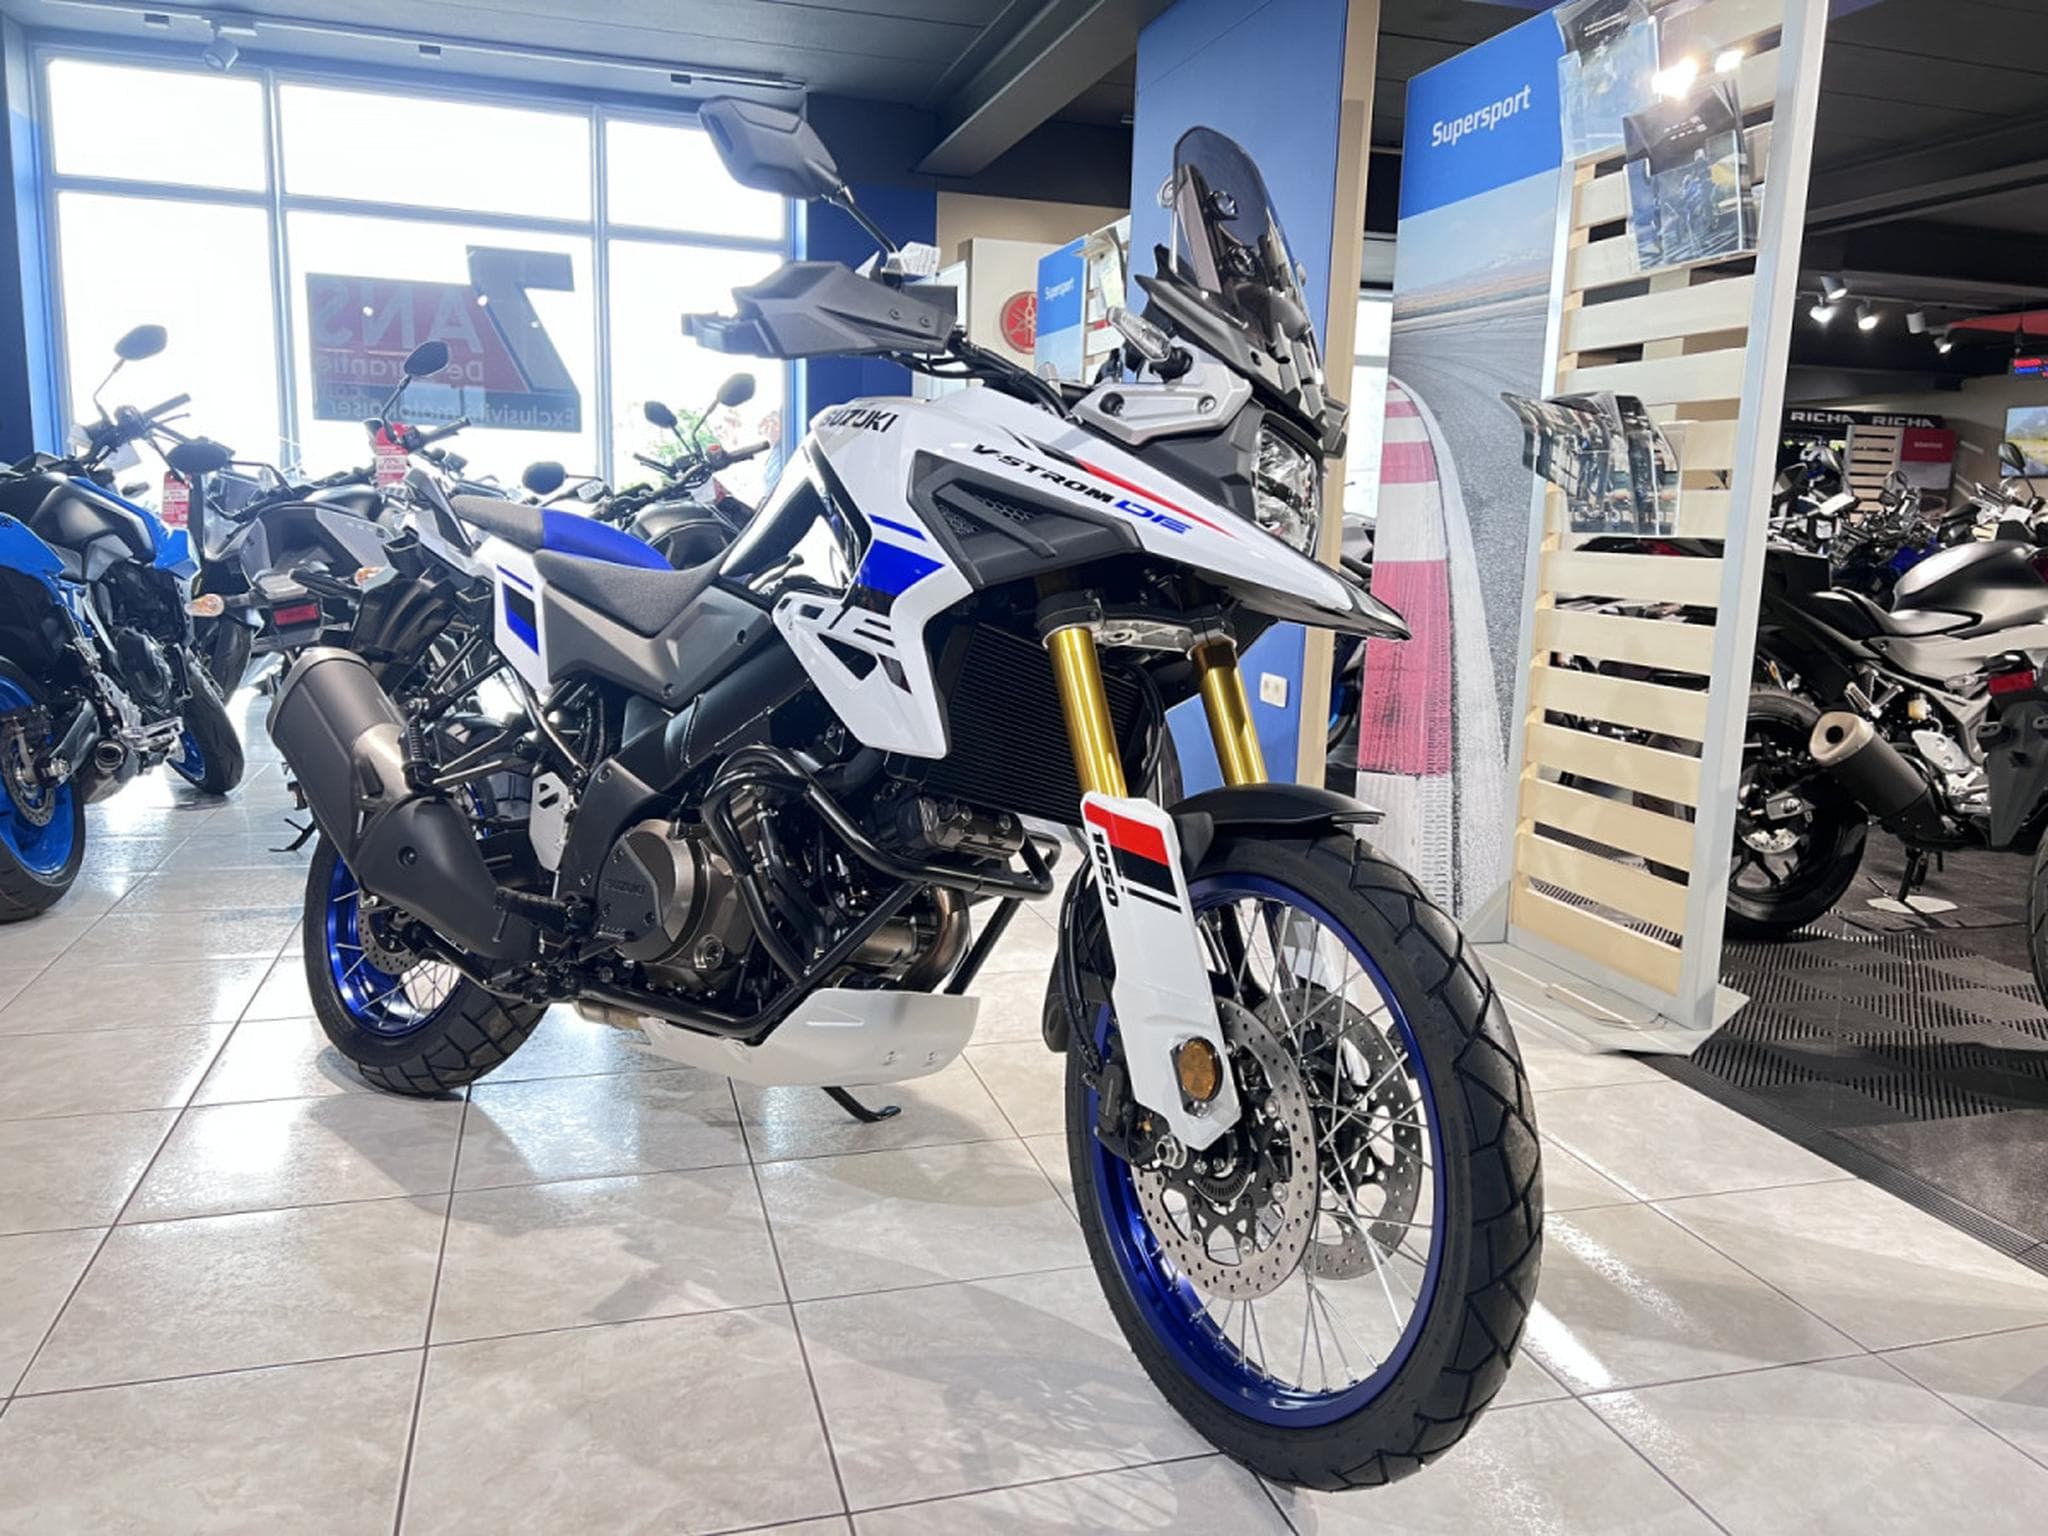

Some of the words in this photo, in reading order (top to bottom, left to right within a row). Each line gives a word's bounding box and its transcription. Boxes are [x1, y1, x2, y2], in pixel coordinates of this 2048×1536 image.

[1431, 84, 1532, 147] Supersport
[819, 408, 899, 433] SUZUKI
[1790, 411, 1856, 424] RICHA
[1872, 415, 1936, 428] RICHA
[973, 444, 1115, 504] V-STROM
[1114, 499, 1192, 535] DE
[1092, 832, 1120, 908] 1050
